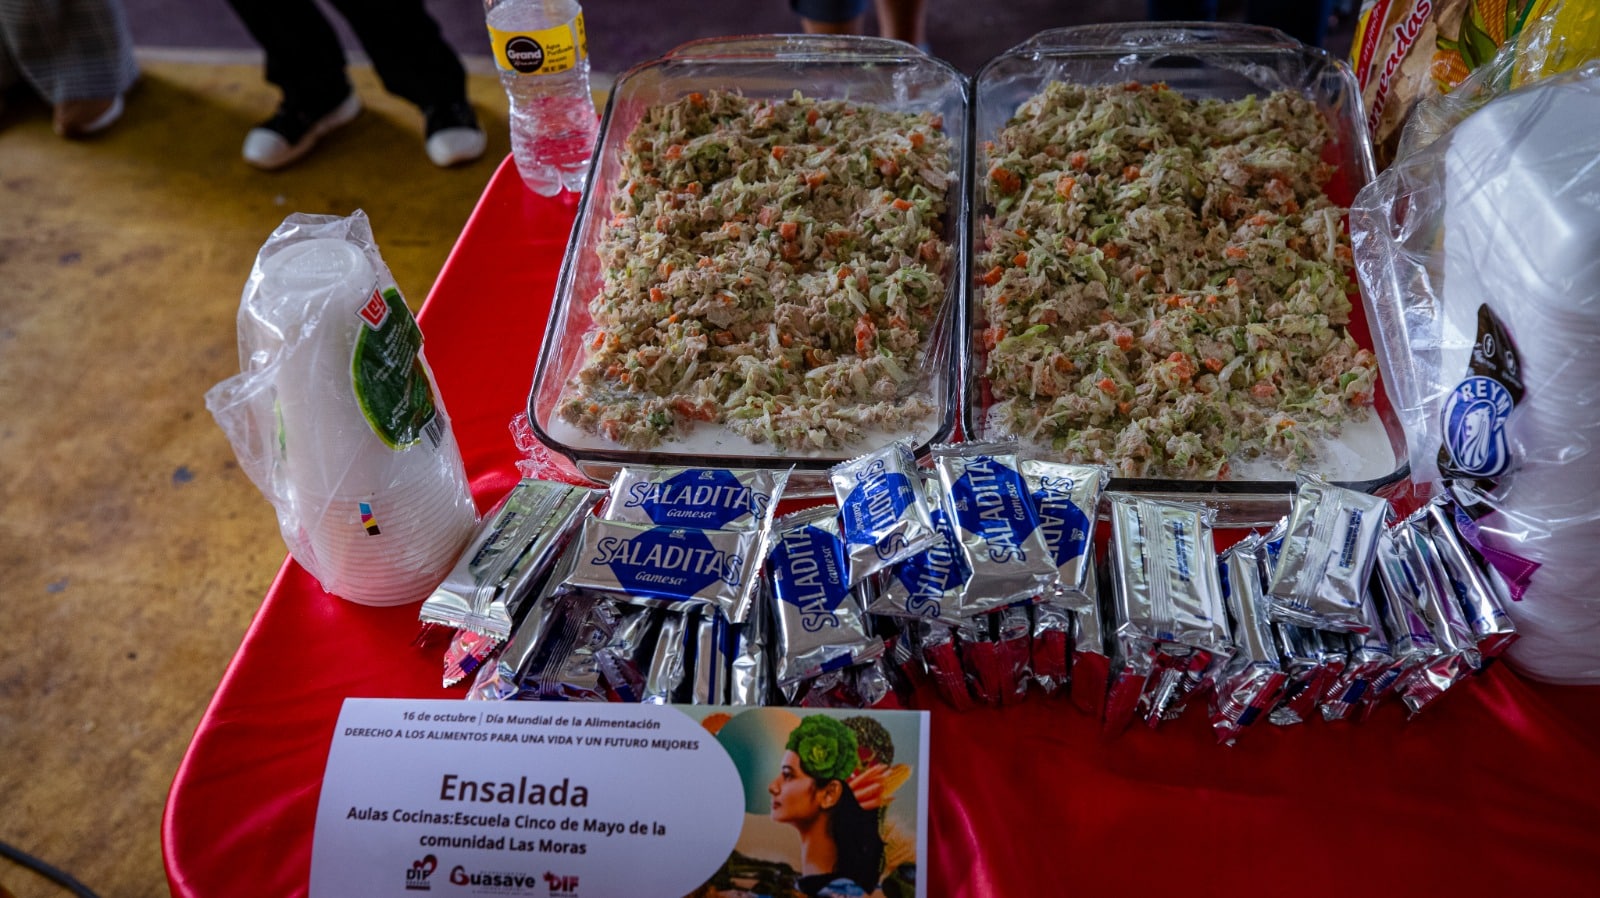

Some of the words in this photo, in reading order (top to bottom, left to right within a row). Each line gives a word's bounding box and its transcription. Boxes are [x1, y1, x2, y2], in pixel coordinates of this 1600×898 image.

[507, 48, 542, 60] Grand
[1462, 381, 1511, 431] REYMA
[624, 482, 770, 519] SALADITAS
[667, 508, 714, 519] Gamesa
[1008, 481, 1025, 521] Gamesa
[592, 537, 743, 587] SALADITAS
[828, 546, 840, 586] Gamesa
[635, 570, 684, 587] Gamesa
[783, 522, 839, 632] SALADITA
[404, 712, 415, 720] 16
[417, 712, 431, 721] de
[433, 713, 476, 723] octubre
[486, 714, 504, 724] Día
[507, 715, 553, 725] Mundial
[555, 716, 569, 726] de
[572, 717, 582, 727] la
[584, 718, 660, 729] Alimentación
[344, 728, 393, 738] DERECHO
[394, 729, 402, 738] A
[405, 730, 425, 739] LOS
[427, 731, 488, 741] ALIMENTOS
[490, 733, 518, 742] PARA
[521, 735, 544, 743] UNA
[548, 736, 573, 745] VIDA
[576, 736, 583, 745] Y
[585, 737, 602, 746] UN
[604, 737, 648, 748] FUTURO
[651, 739, 699, 751] MEJORES
[440, 774, 588, 807] Ensalada
[347, 807, 388, 821] Aulas
[392, 809, 510, 828] Cocinas:Escuela
[515, 815, 556, 830] Cinco
[560, 817, 579, 831] de
[583, 819, 625, 837] Mayo
[629, 821, 648, 835] de
[652, 821, 666, 836] la
[420, 835, 505, 850] comunidad
[509, 837, 534, 852] Las
[539, 839, 586, 855] Moras
[449, 865, 535, 889] Guasave
[549, 875, 579, 893] DIF
